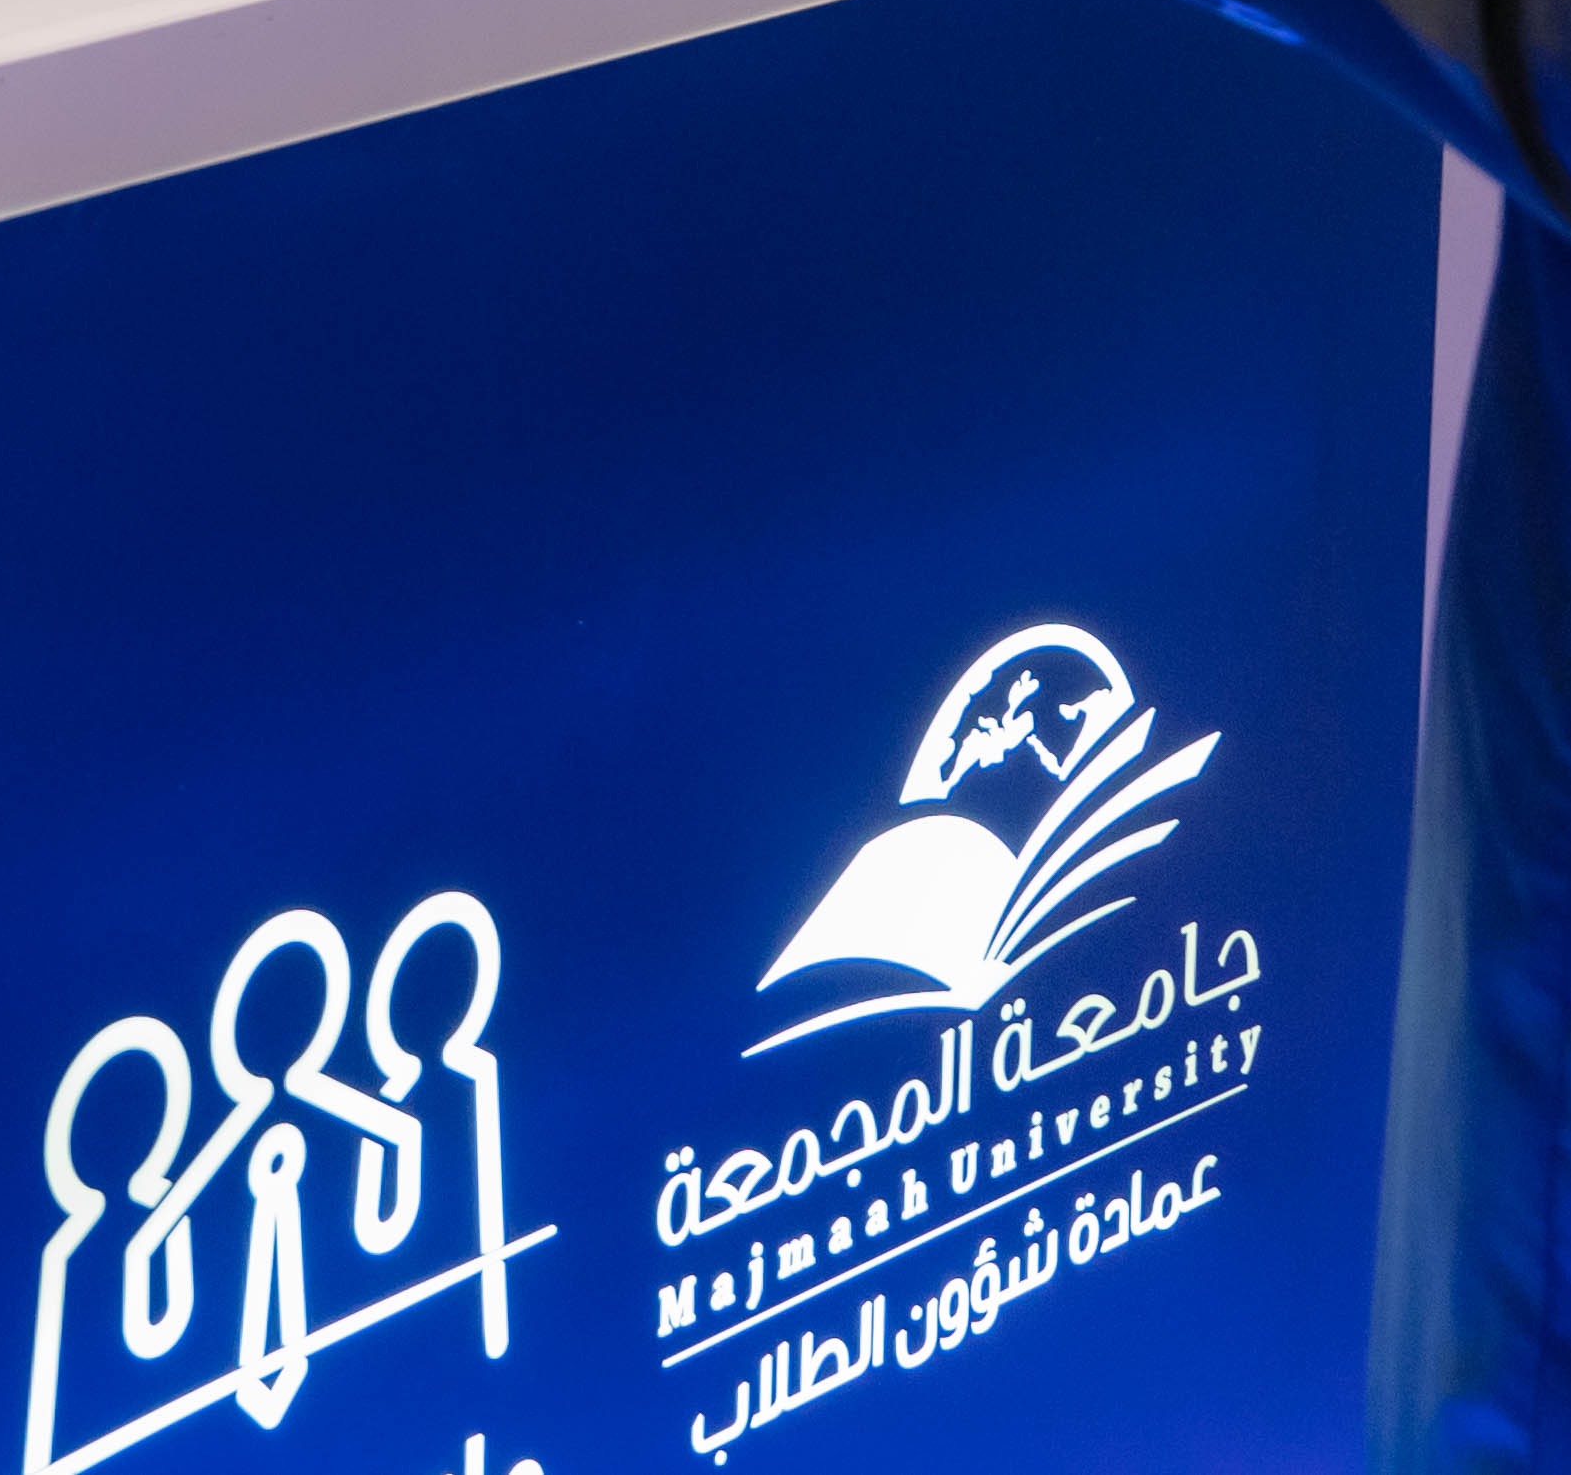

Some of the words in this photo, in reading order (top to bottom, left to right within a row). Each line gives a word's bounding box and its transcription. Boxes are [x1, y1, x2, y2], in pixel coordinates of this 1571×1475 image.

[991, 921, 1261, 1092] جامعة
[656, 1018, 973, 1247] المجمعة
[656, 1168, 929, 1338] Majmaah
[950, 1024, 1262, 1195] University
[1068, 1153, 1222, 1265] عمادة
[895, 1207, 1059, 1370] شؤون
[690, 1293, 885, 1467] الطلاب
